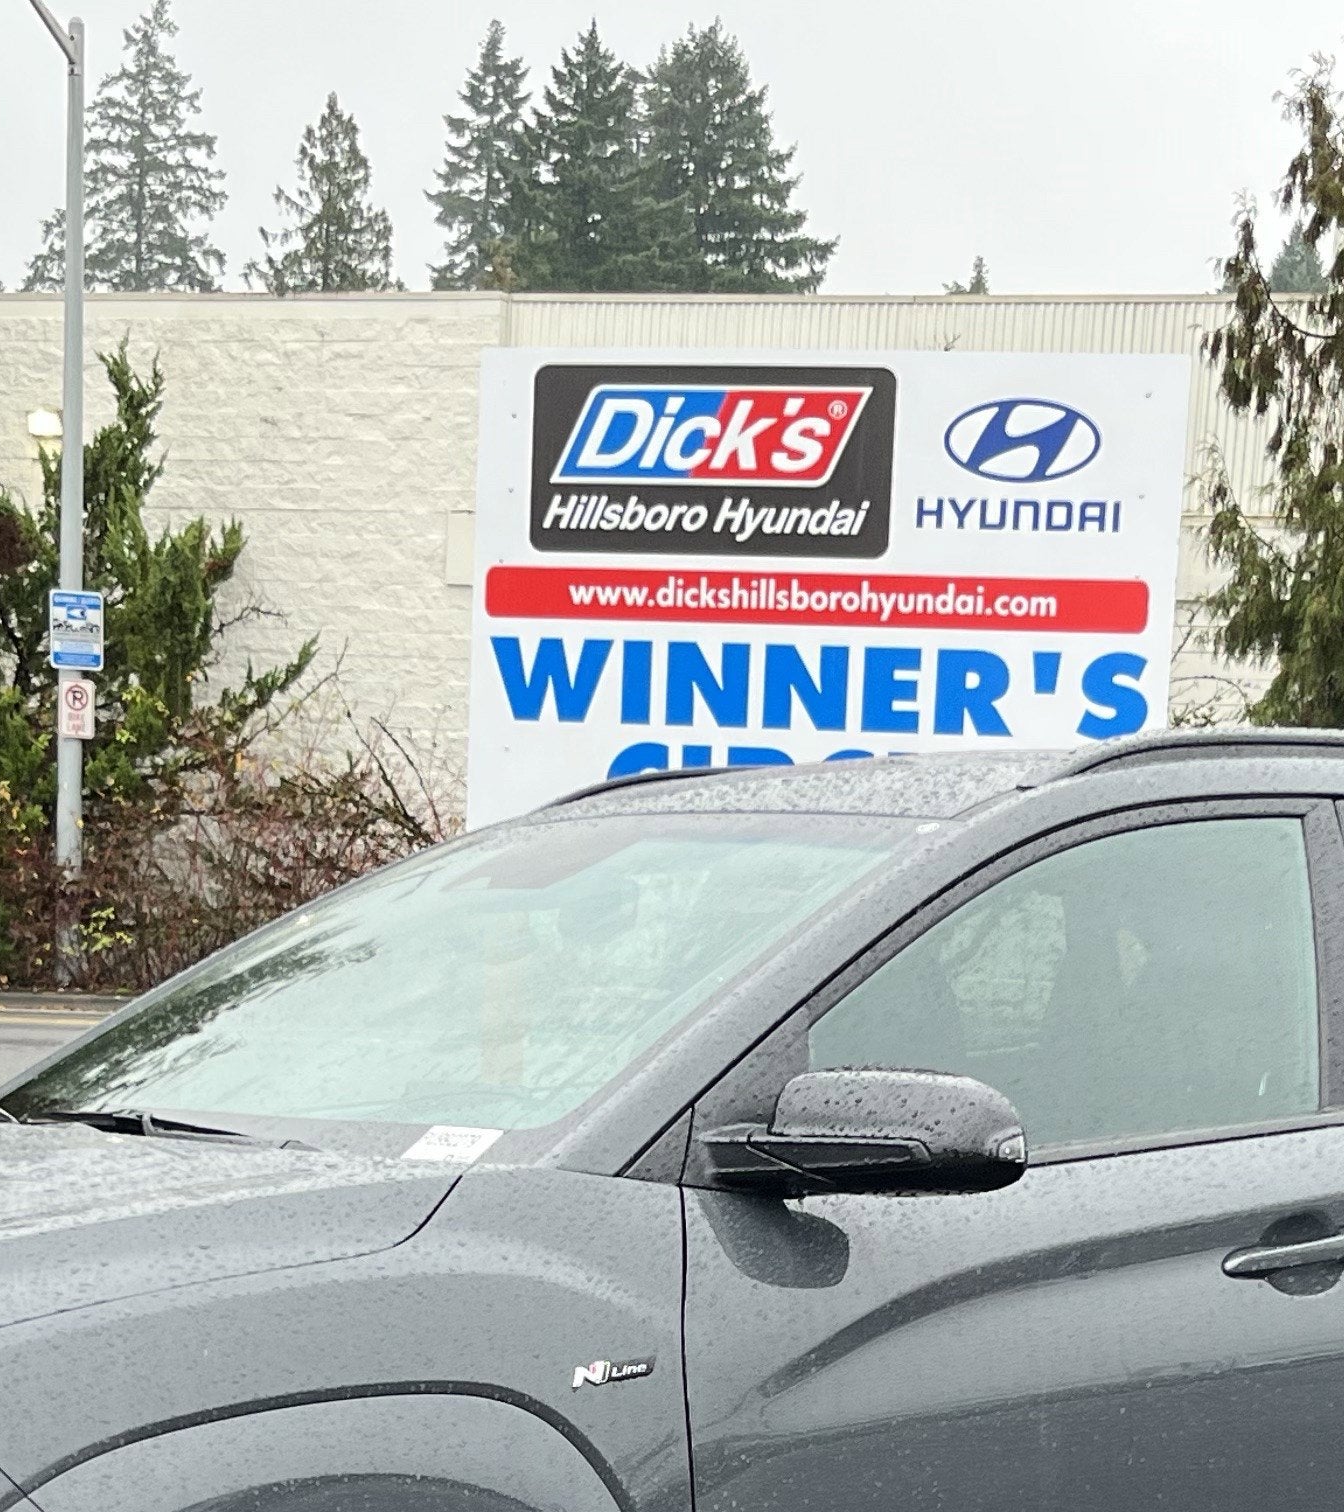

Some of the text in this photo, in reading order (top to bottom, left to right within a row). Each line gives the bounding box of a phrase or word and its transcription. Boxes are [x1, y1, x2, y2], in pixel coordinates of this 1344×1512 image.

[576, 396, 831, 473] Dick's
[542, 495, 870, 543] Hillsboro Hyundai
[916, 497, 1121, 533] HYUNDAI
[567, 580, 1058, 621] www.dickshillsborohyundai.com
[490, 636, 1149, 739] WINNER'S
